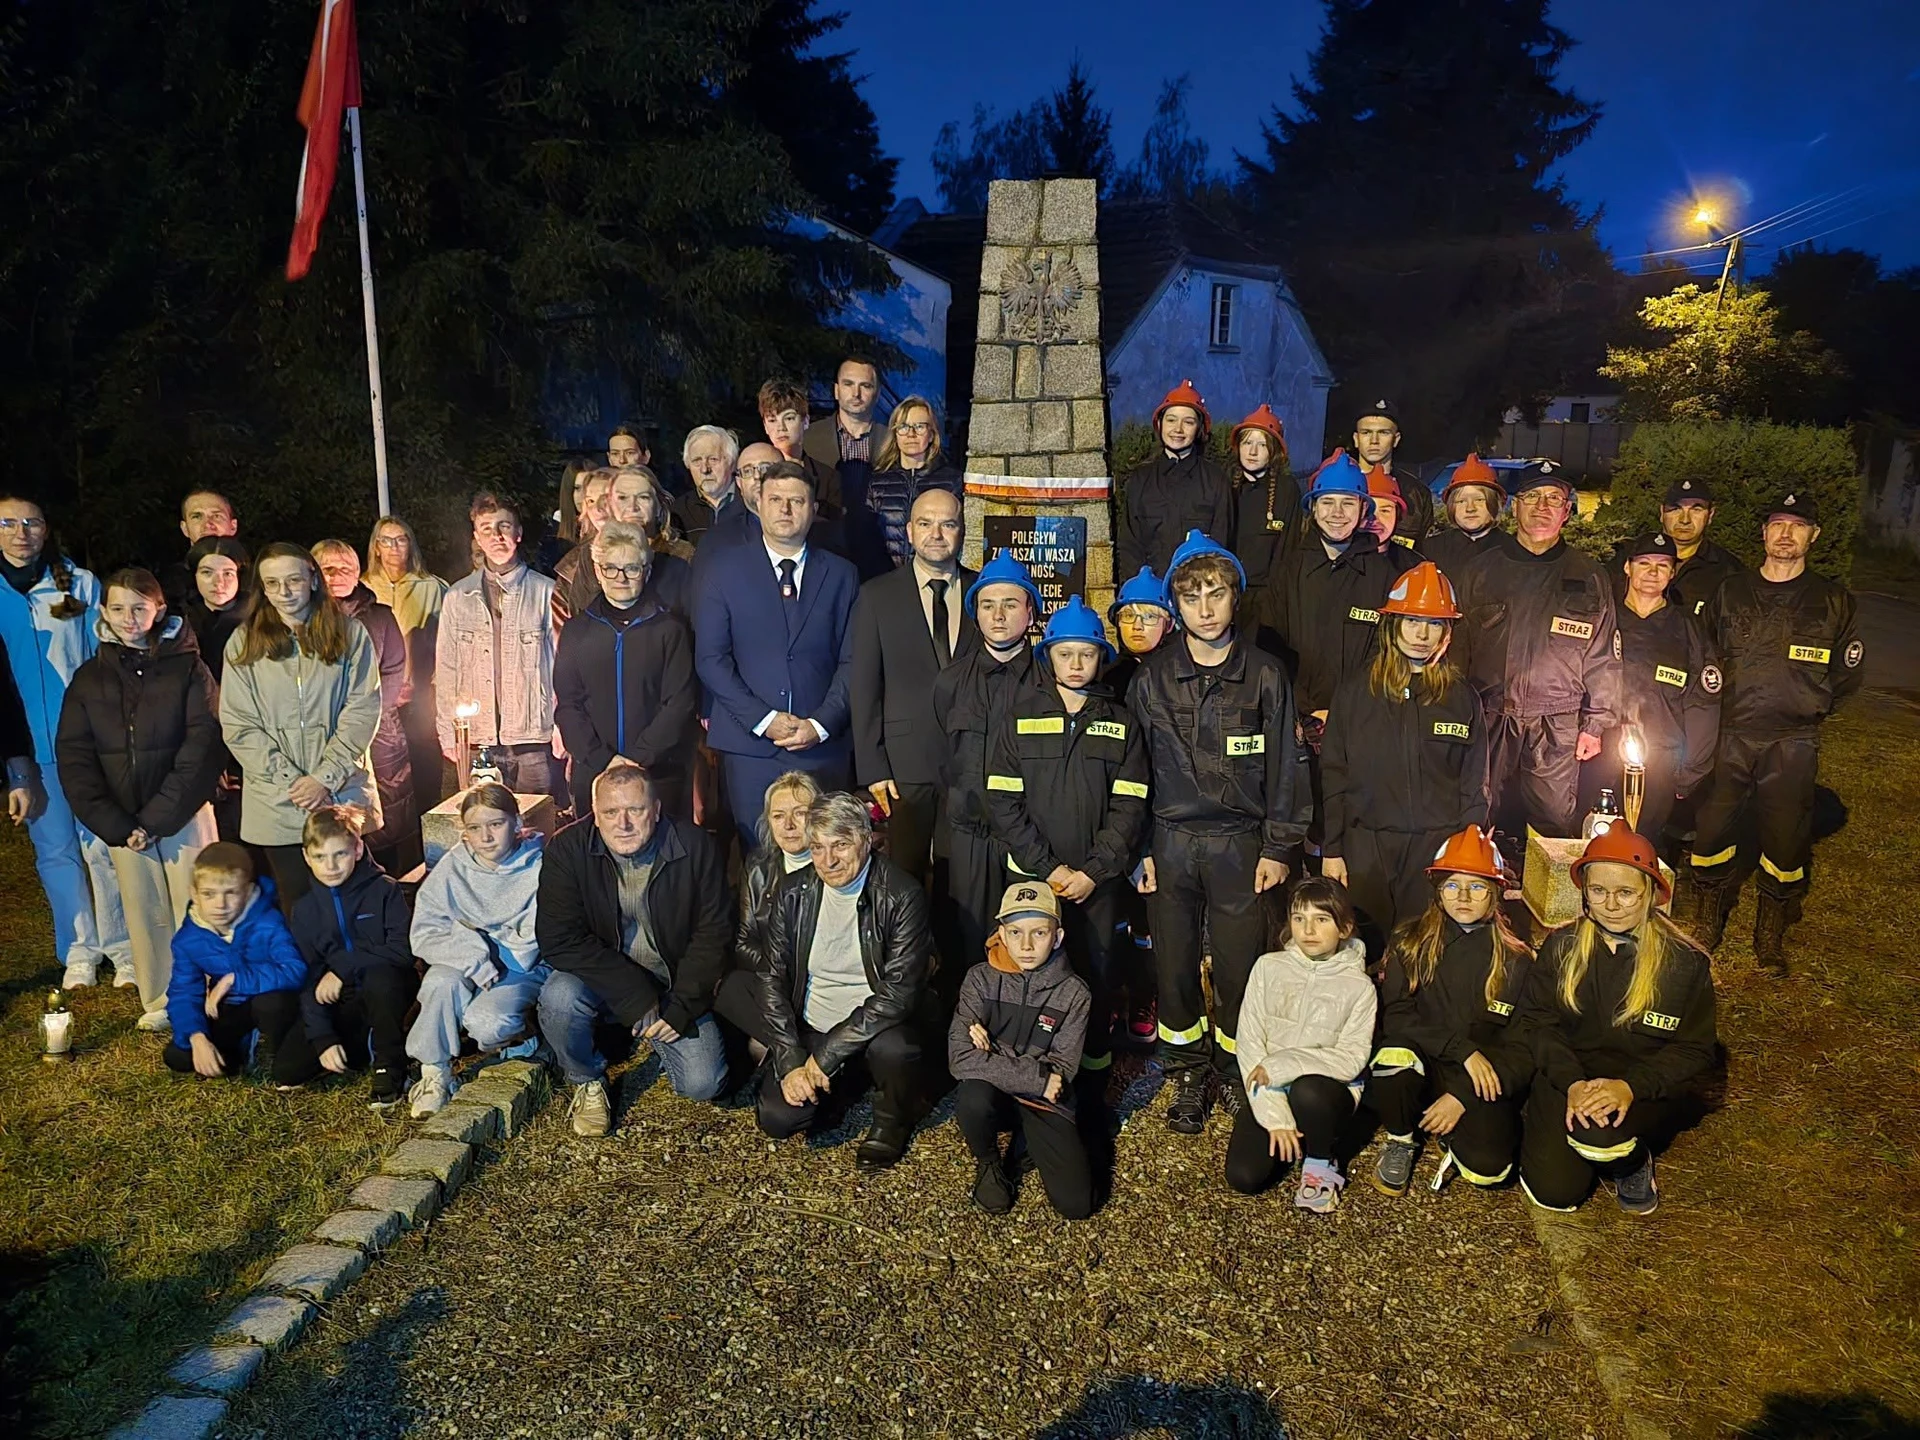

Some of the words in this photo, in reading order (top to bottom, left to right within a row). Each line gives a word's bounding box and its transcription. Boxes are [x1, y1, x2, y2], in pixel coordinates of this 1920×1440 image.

[1011, 530, 1057, 545] POLEGŁYM
[991, 547, 1002, 560] Z
[1045, 548, 1076, 564] WASZĄ
